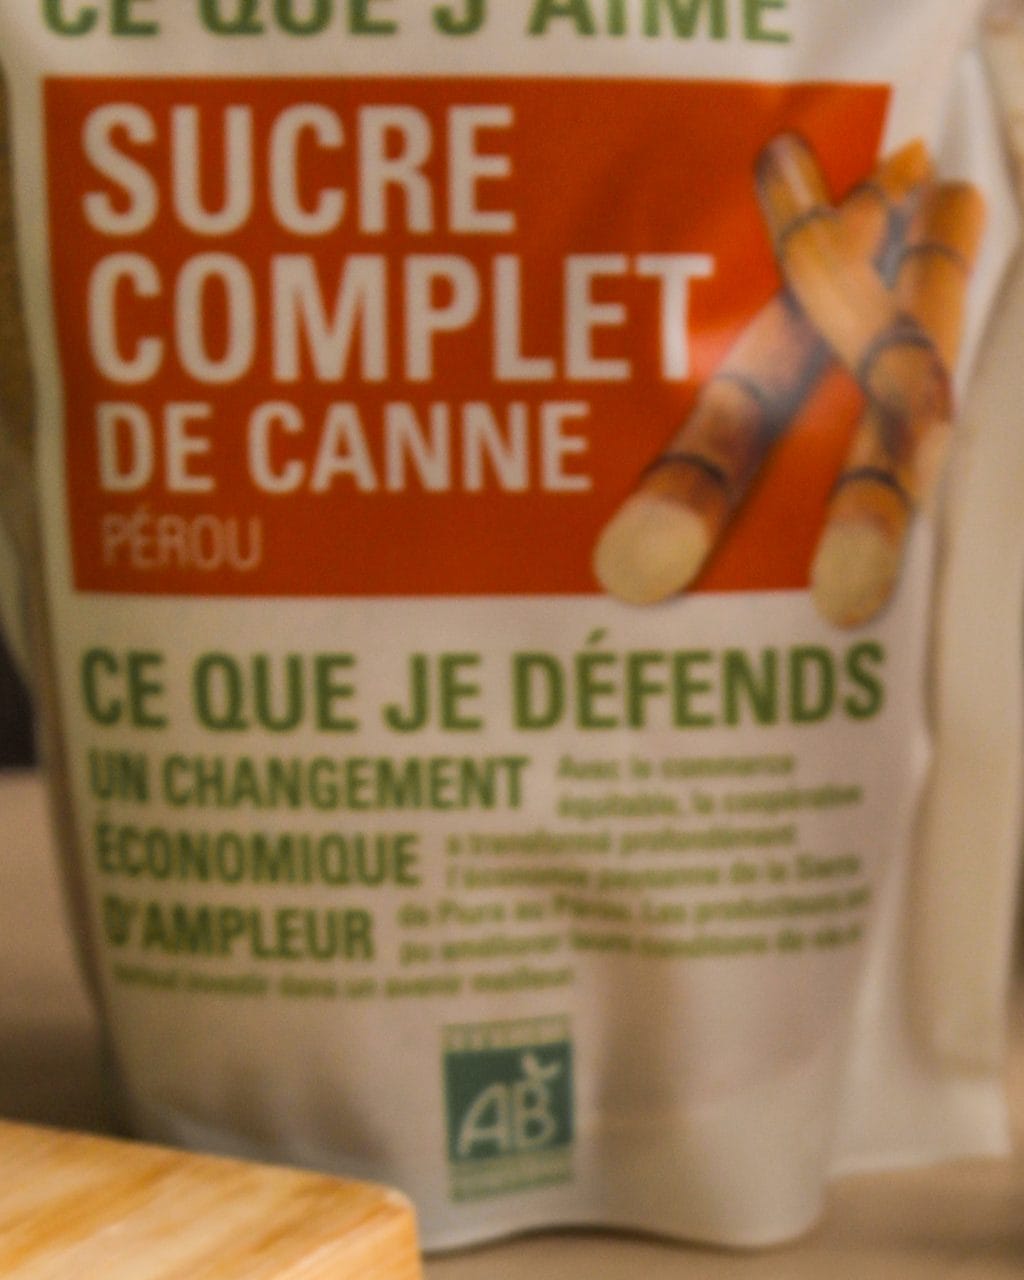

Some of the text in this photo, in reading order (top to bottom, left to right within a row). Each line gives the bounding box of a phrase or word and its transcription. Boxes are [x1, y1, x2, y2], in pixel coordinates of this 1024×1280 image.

[82, 103, 516, 237] SUCRE
[86, 253, 715, 386] COMPLET
[97, 402, 593, 494] DE CANNE
[101, 508, 263, 571] PÉROU
[80, 628, 885, 735] CE QUE JE DÉFENDS
[86, 747, 532, 811] UN CHANGEMENT
[95, 806, 421, 888] ÉCONOMIQUE
[103, 897, 375, 962] D'AMPLEUR
[456, 1080, 557, 1157] AB
